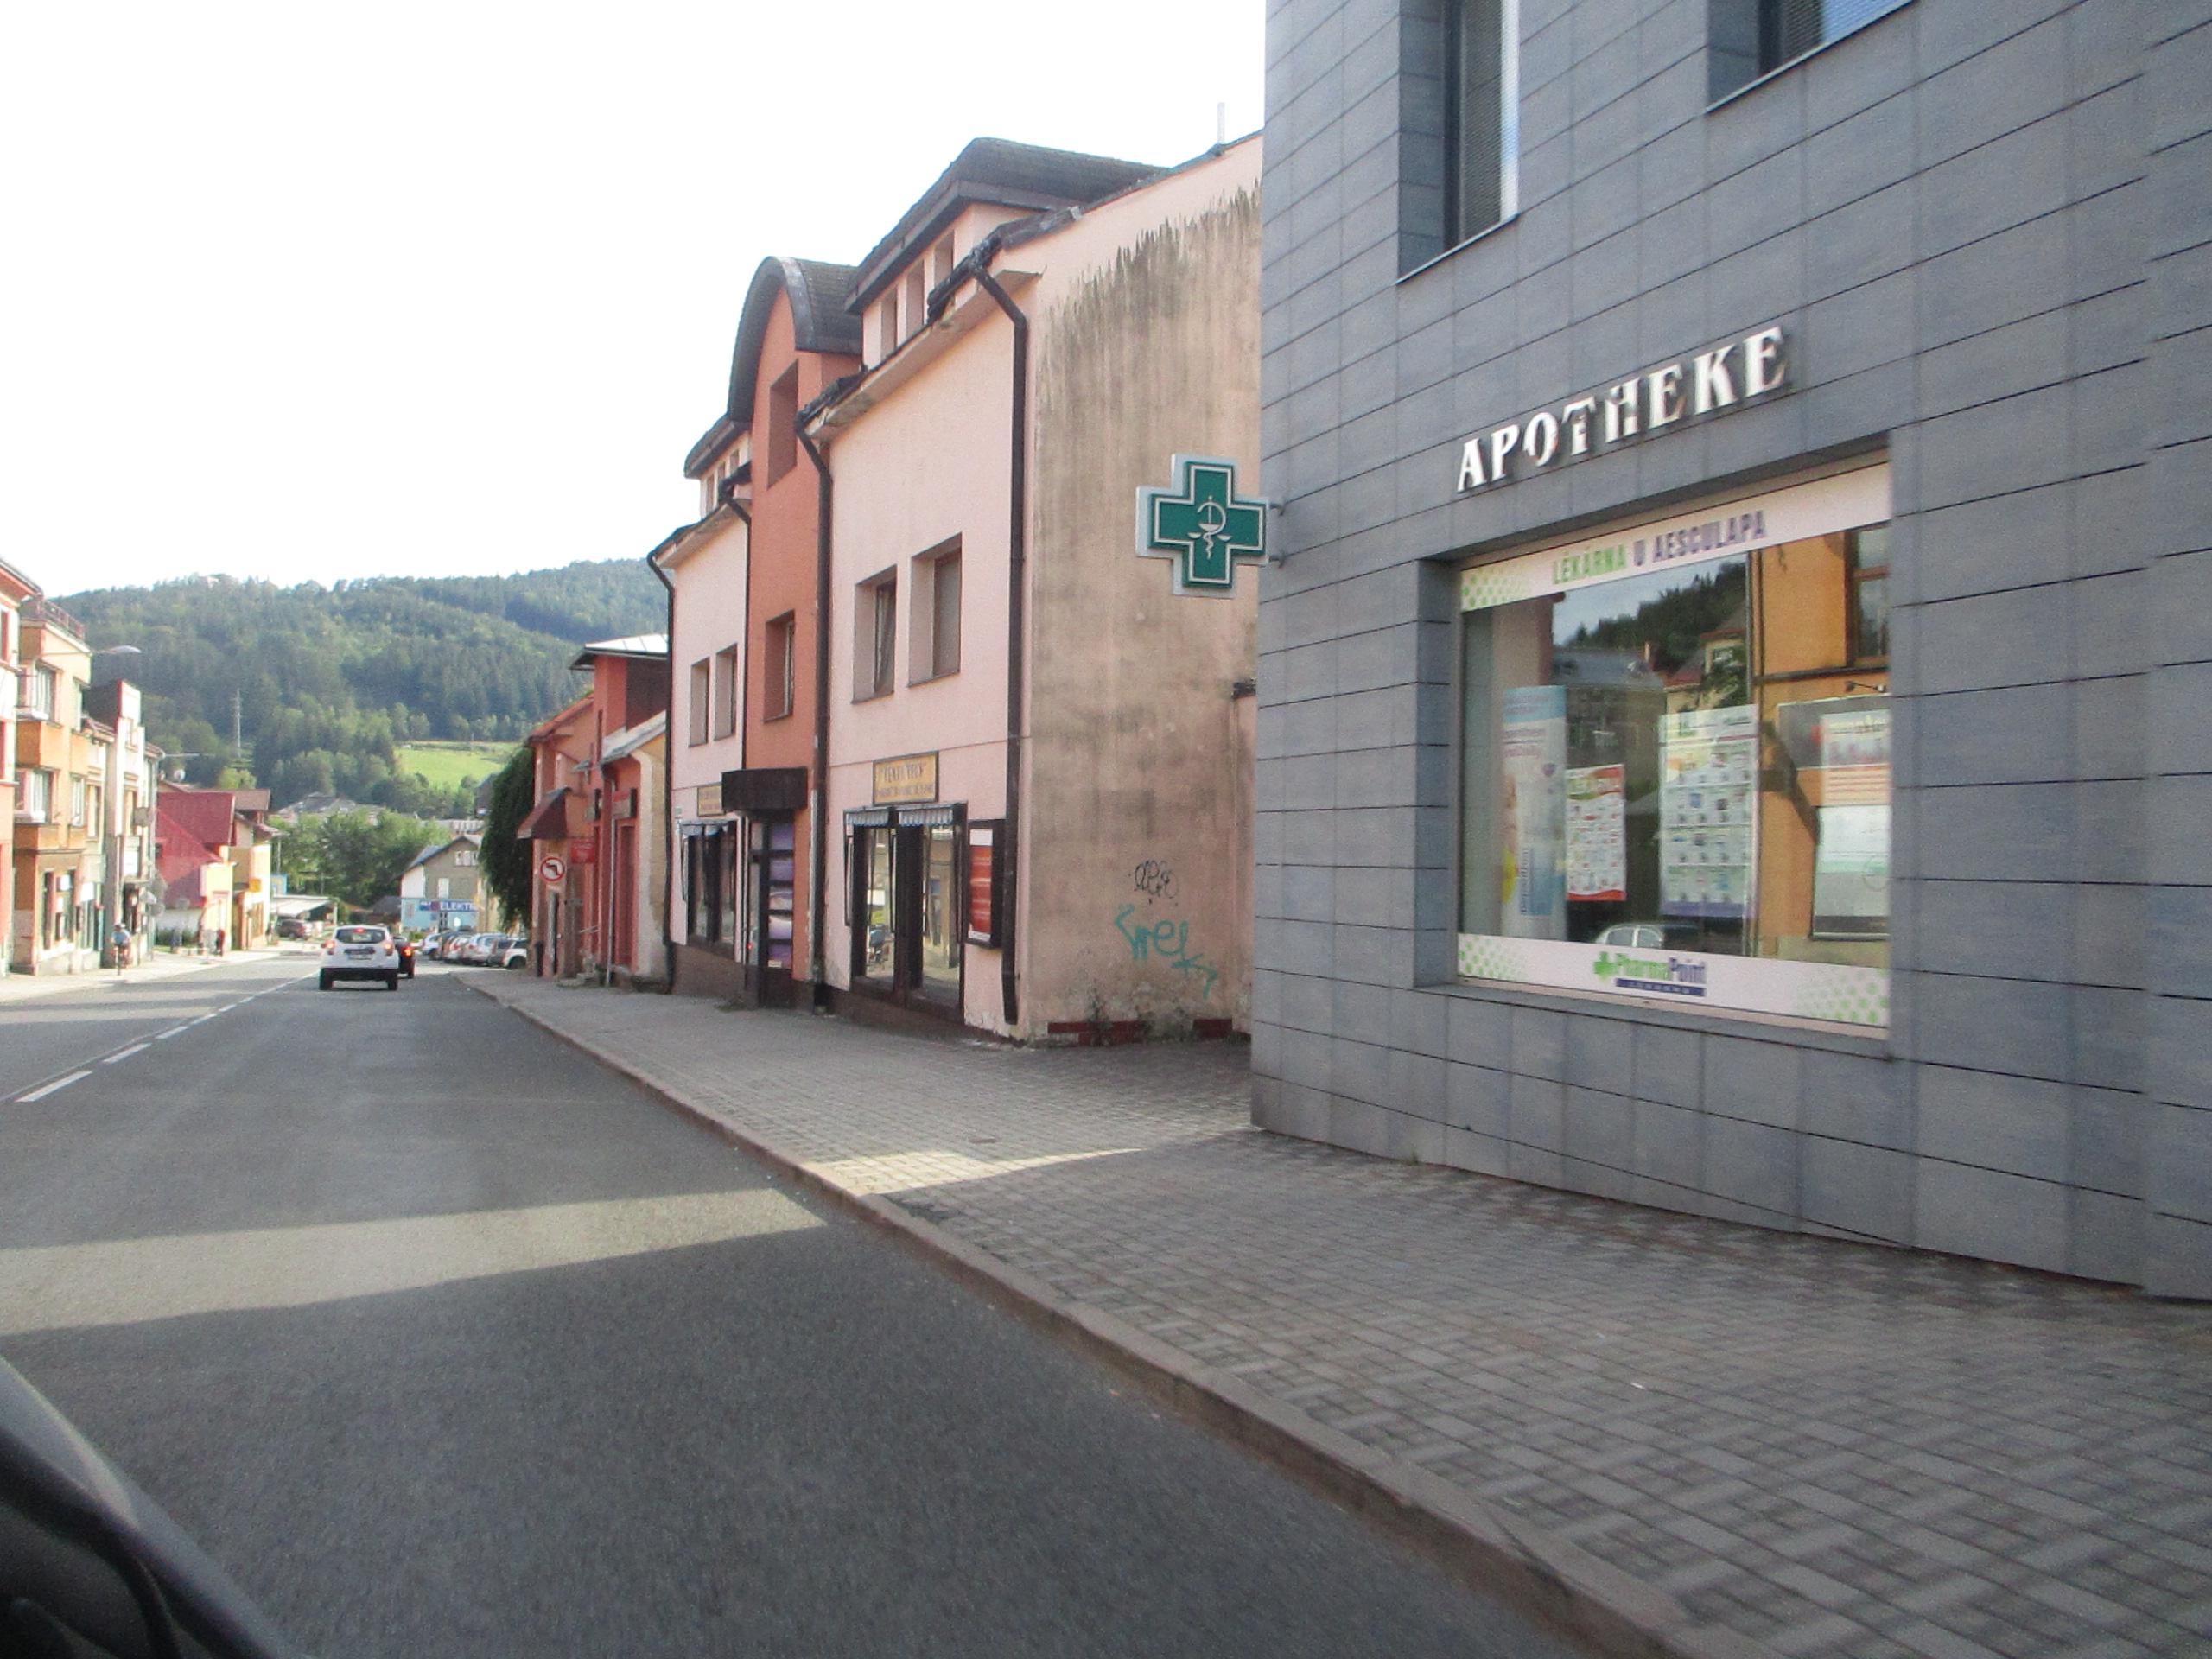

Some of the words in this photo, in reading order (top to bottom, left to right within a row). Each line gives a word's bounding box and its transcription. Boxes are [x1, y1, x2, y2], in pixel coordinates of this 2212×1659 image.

[1456, 326, 1786, 493] APOTHEKE
[1633, 538, 1646, 566] U
[1652, 510, 1766, 563] AESCULAPA
